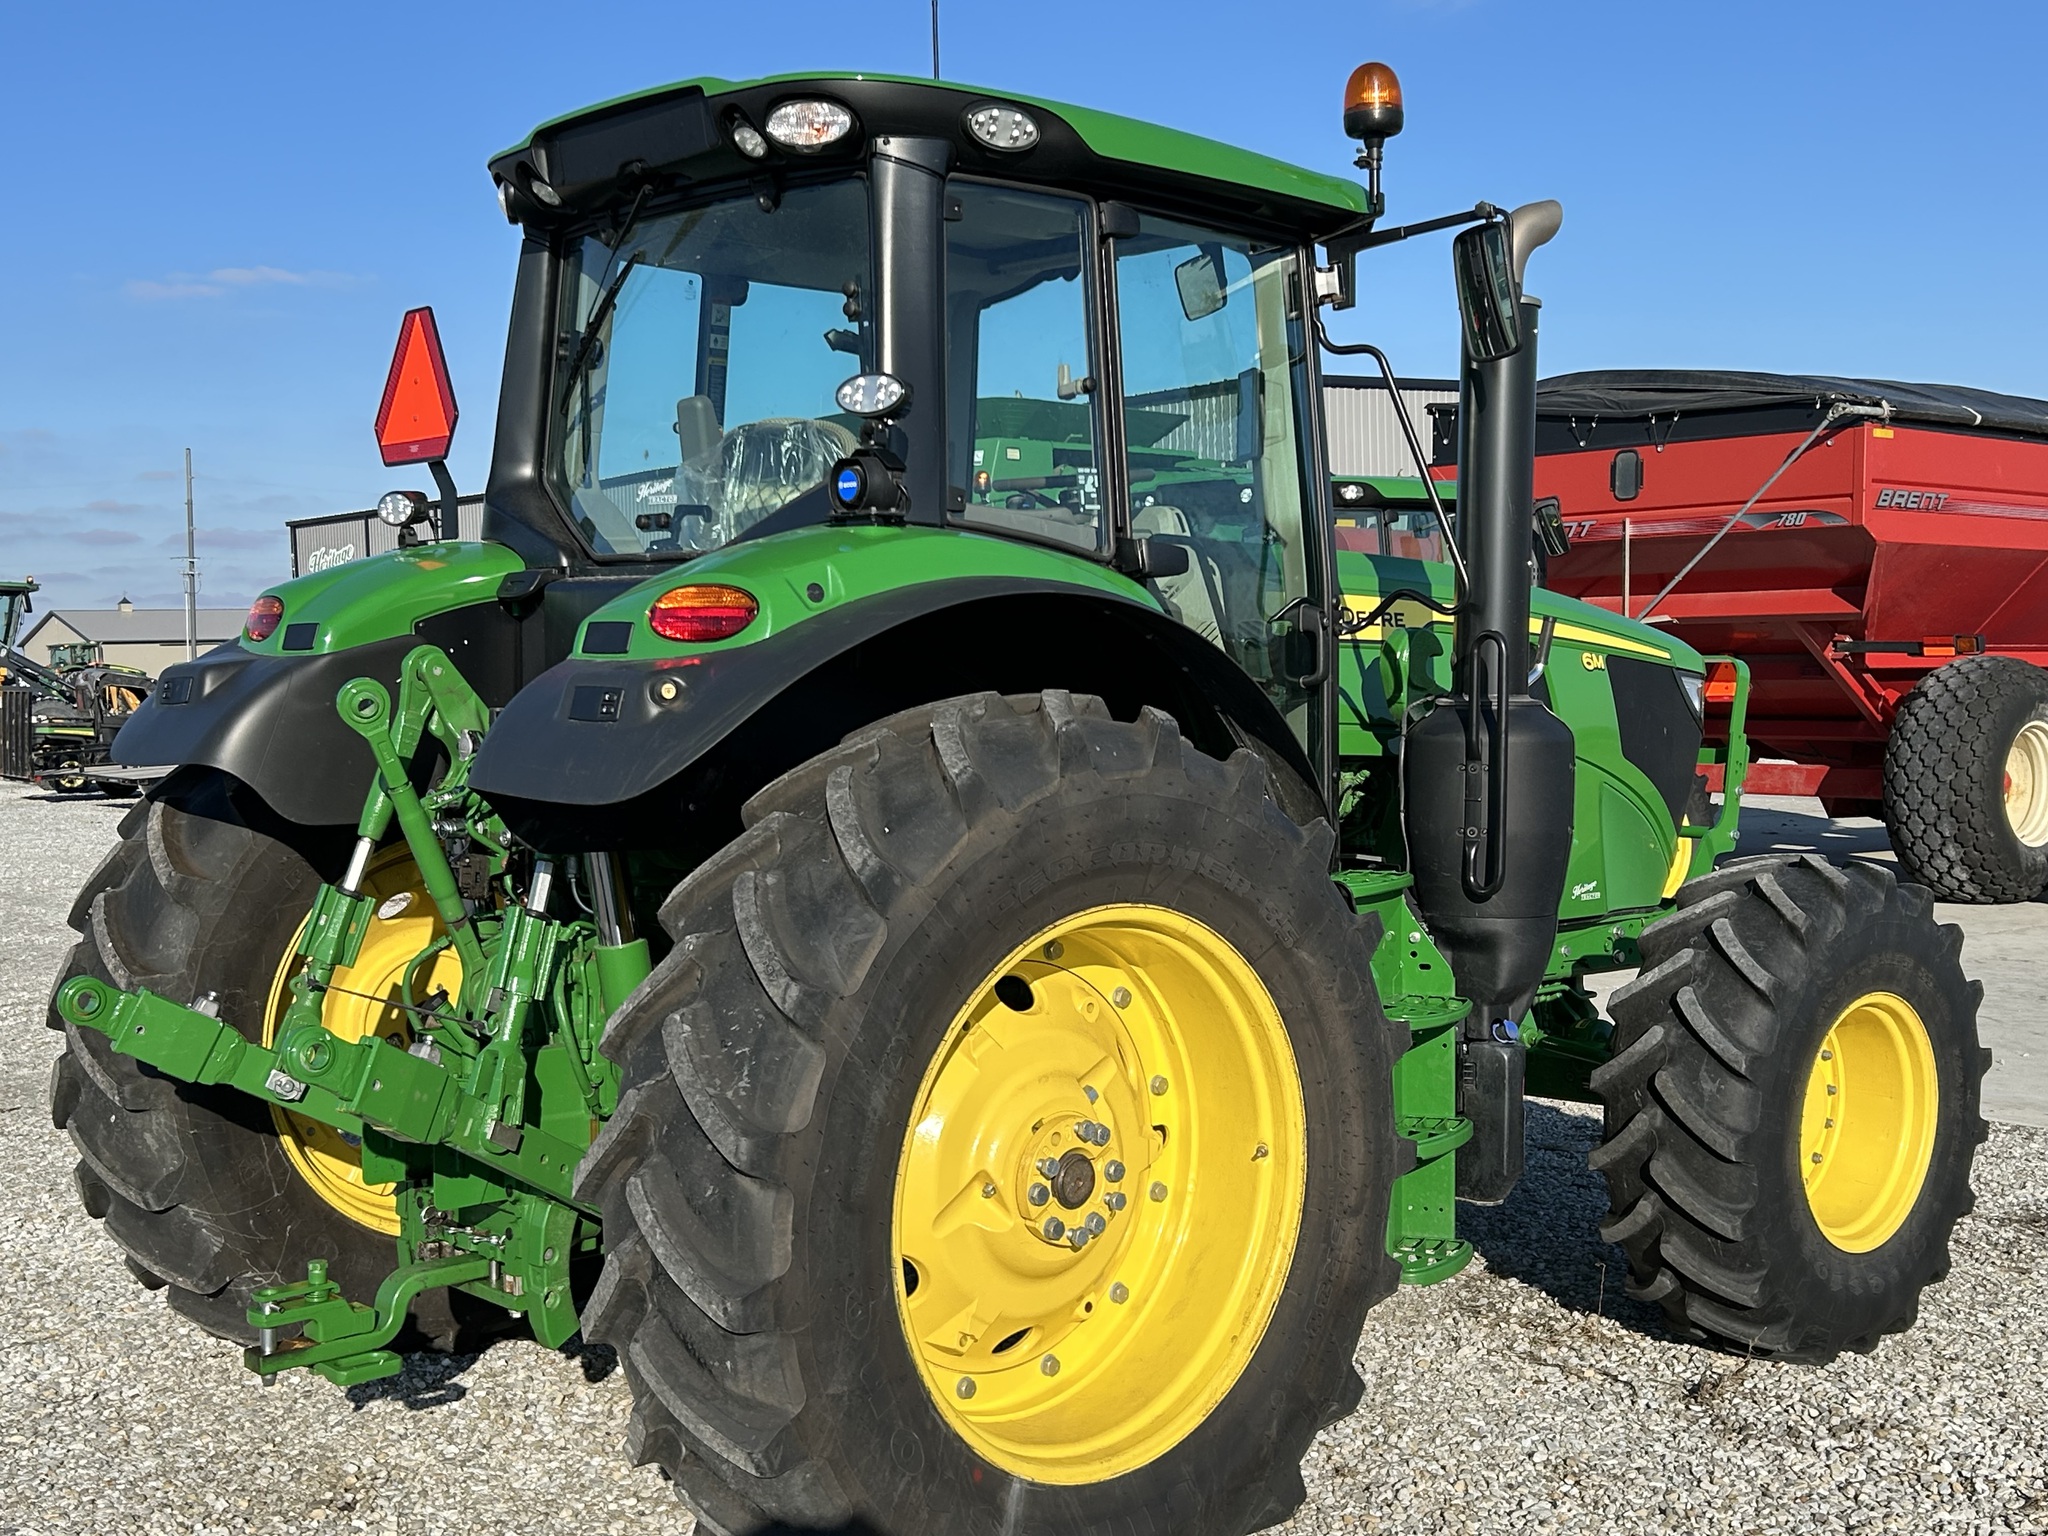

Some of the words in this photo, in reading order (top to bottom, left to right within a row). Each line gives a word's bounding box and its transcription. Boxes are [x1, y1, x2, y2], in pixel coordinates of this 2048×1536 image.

[1876, 489, 1949, 510] BRENT
[1777, 512, 1807, 527] 780
[309, 544, 354, 573] Heritage
[1341, 606, 1406, 627] DERE
[1581, 652, 1605, 671] 6M
